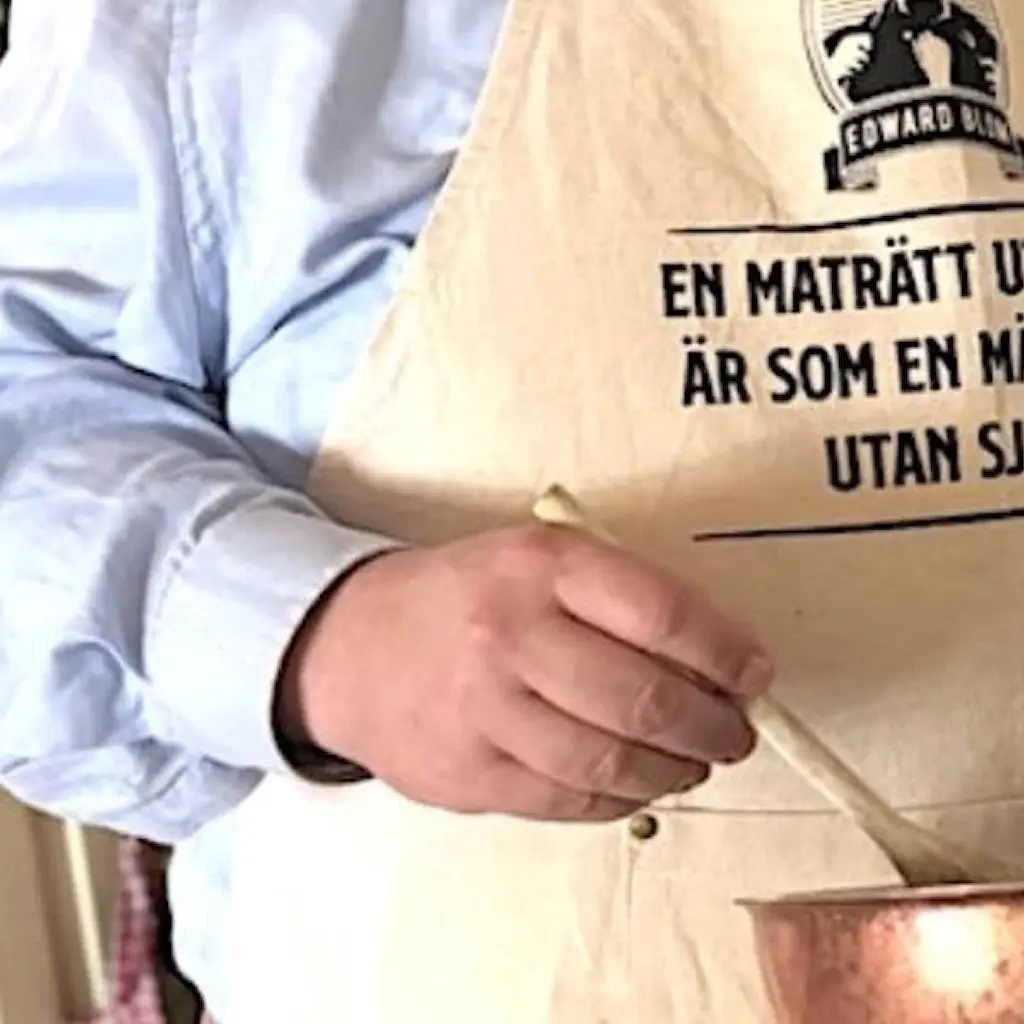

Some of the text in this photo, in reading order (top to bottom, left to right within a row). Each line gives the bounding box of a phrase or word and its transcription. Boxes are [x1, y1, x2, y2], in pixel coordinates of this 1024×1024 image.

[845, 102, 954, 155] EDWARD
[661, 263, 726, 317] EN
[746, 235, 975, 316] MATRÄTT
[682, 336, 750, 406] ÄR
[768, 342, 878, 403] SOM
[895, 334, 962, 393] EN
[824, 426, 962, 492] UTAN
